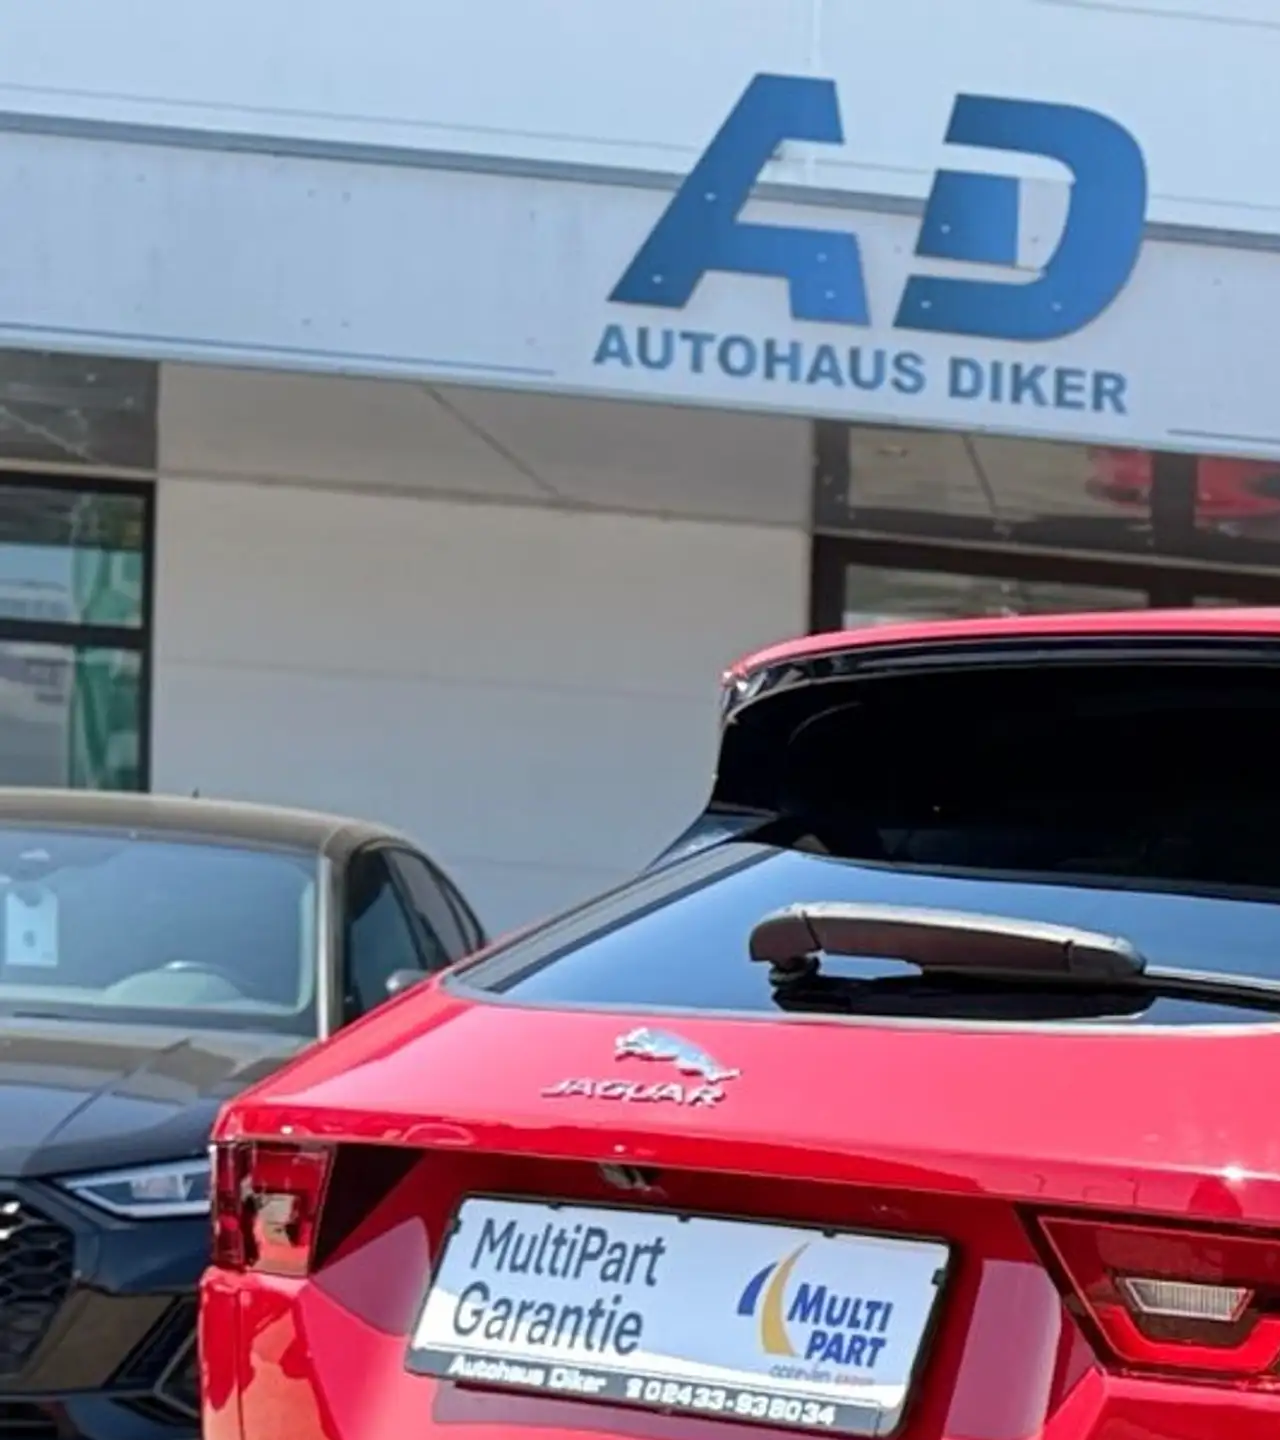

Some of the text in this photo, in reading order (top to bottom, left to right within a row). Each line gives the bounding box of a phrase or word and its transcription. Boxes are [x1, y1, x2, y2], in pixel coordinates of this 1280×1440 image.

[592, 323, 1129, 413] AUTOHAUS DIKER
[541, 1078, 726, 1109] JAGUAR
[470, 1217, 666, 1287] MultiPart
[453, 1280, 643, 1356] Garantie
[803, 1329, 886, 1369] PART
